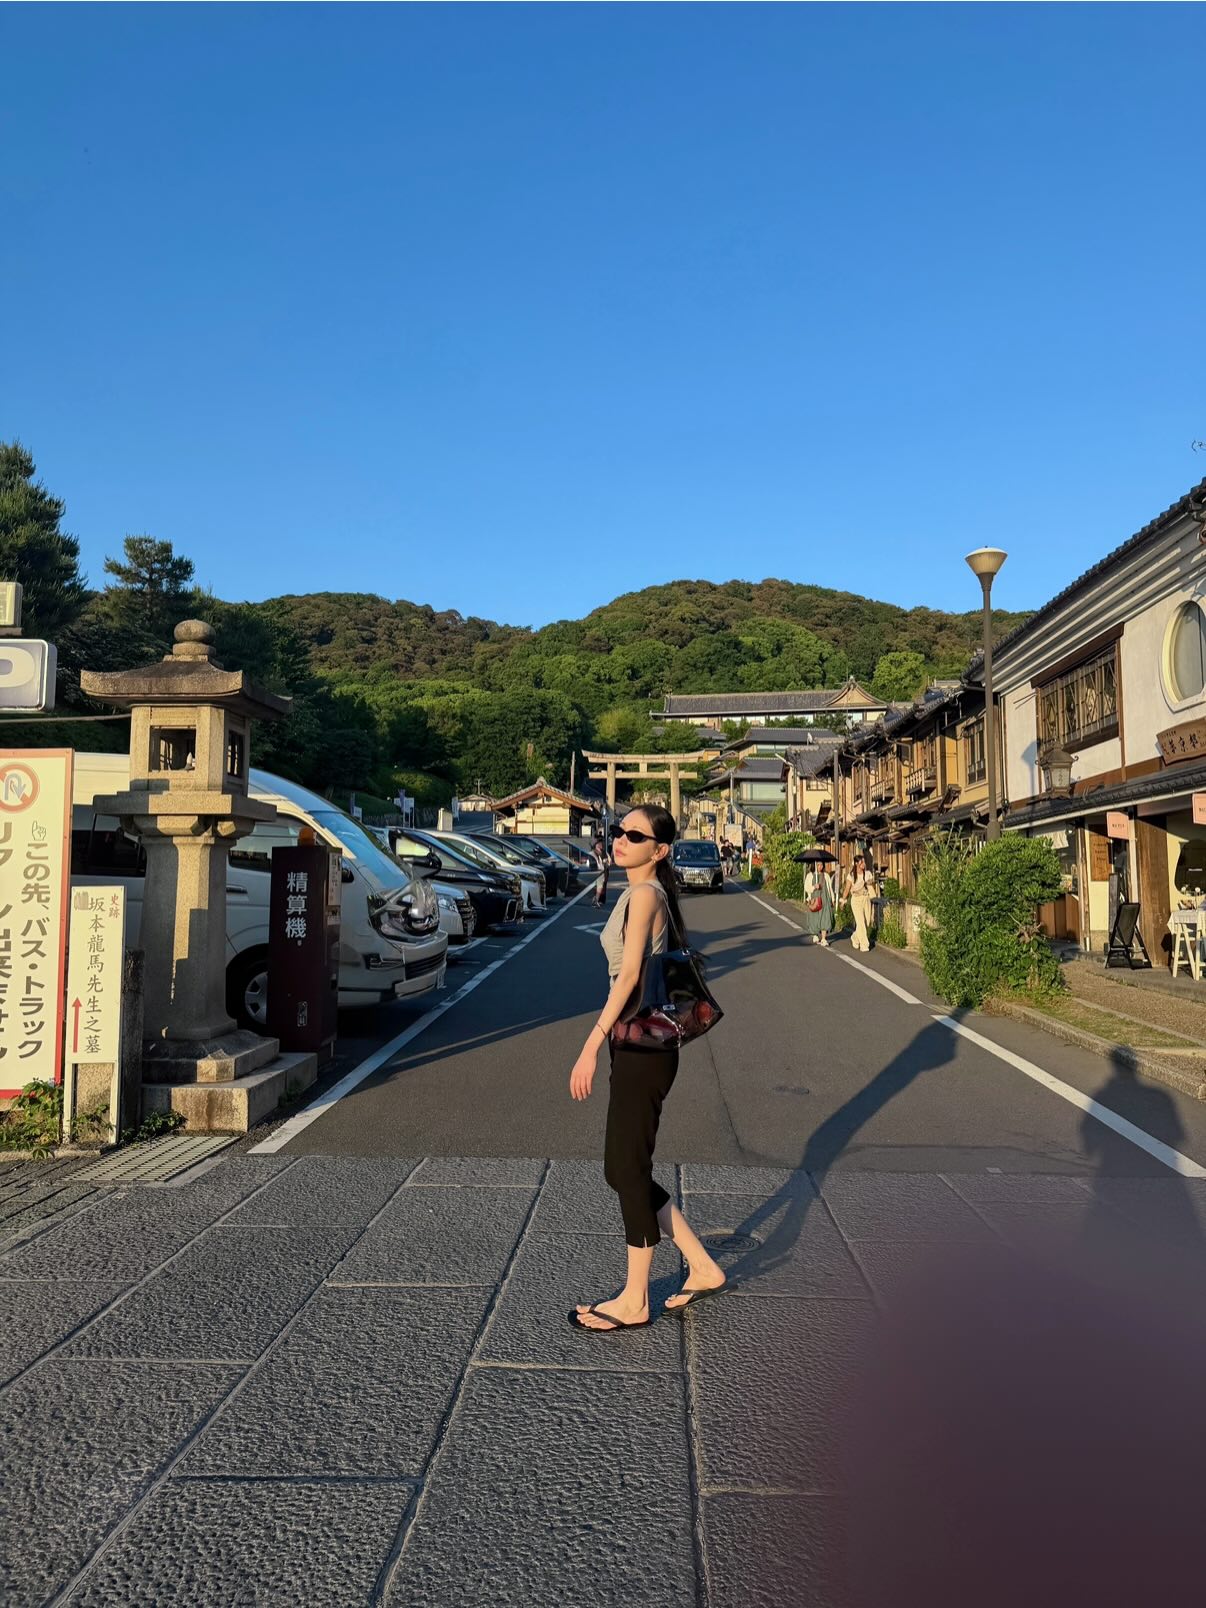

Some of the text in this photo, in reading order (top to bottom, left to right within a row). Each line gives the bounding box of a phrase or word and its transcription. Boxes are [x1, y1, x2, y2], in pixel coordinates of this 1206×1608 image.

[18, 842, 51, 1059] この先、バス・トラック
[108, 893, 120, 919] 史跡
[285, 871, 308, 939] 精算機
[84, 897, 105, 1054] 坂本龍馬先生之墓
